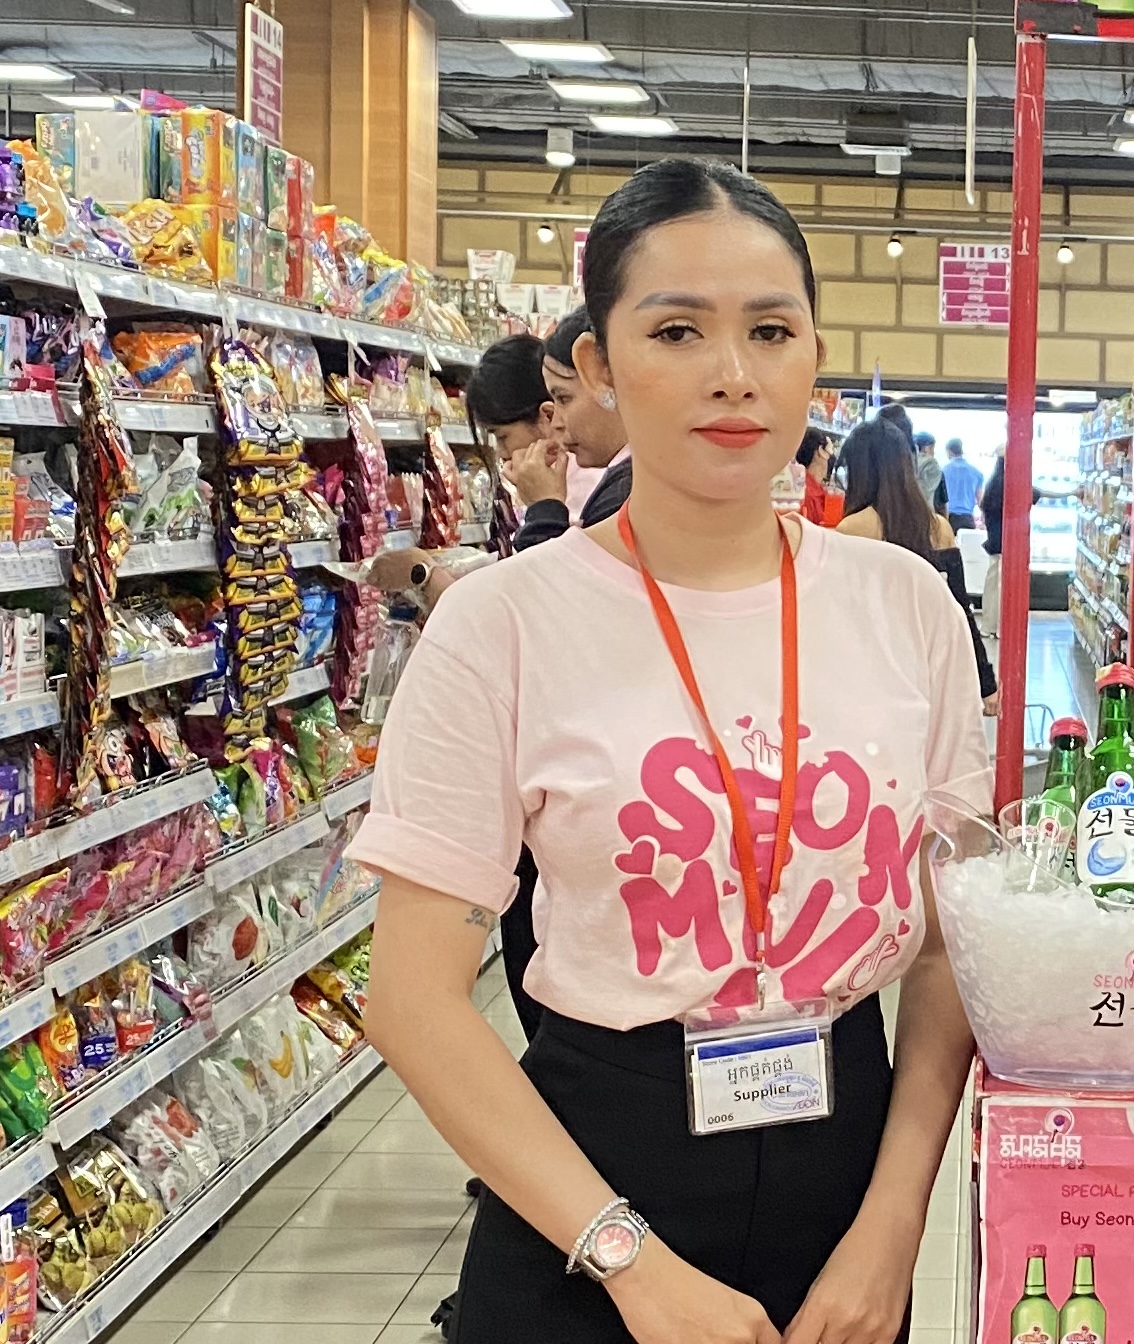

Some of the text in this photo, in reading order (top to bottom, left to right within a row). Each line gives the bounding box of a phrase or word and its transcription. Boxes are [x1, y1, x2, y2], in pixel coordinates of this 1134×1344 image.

[991, 247, 1010, 259] 13
[733, 1083, 792, 1103] Supplier
[707, 1112, 735, 1125] 0006
[1061, 1184, 1125, 1199] SPECIAL
[1060, 1211, 1090, 1230] Buy
